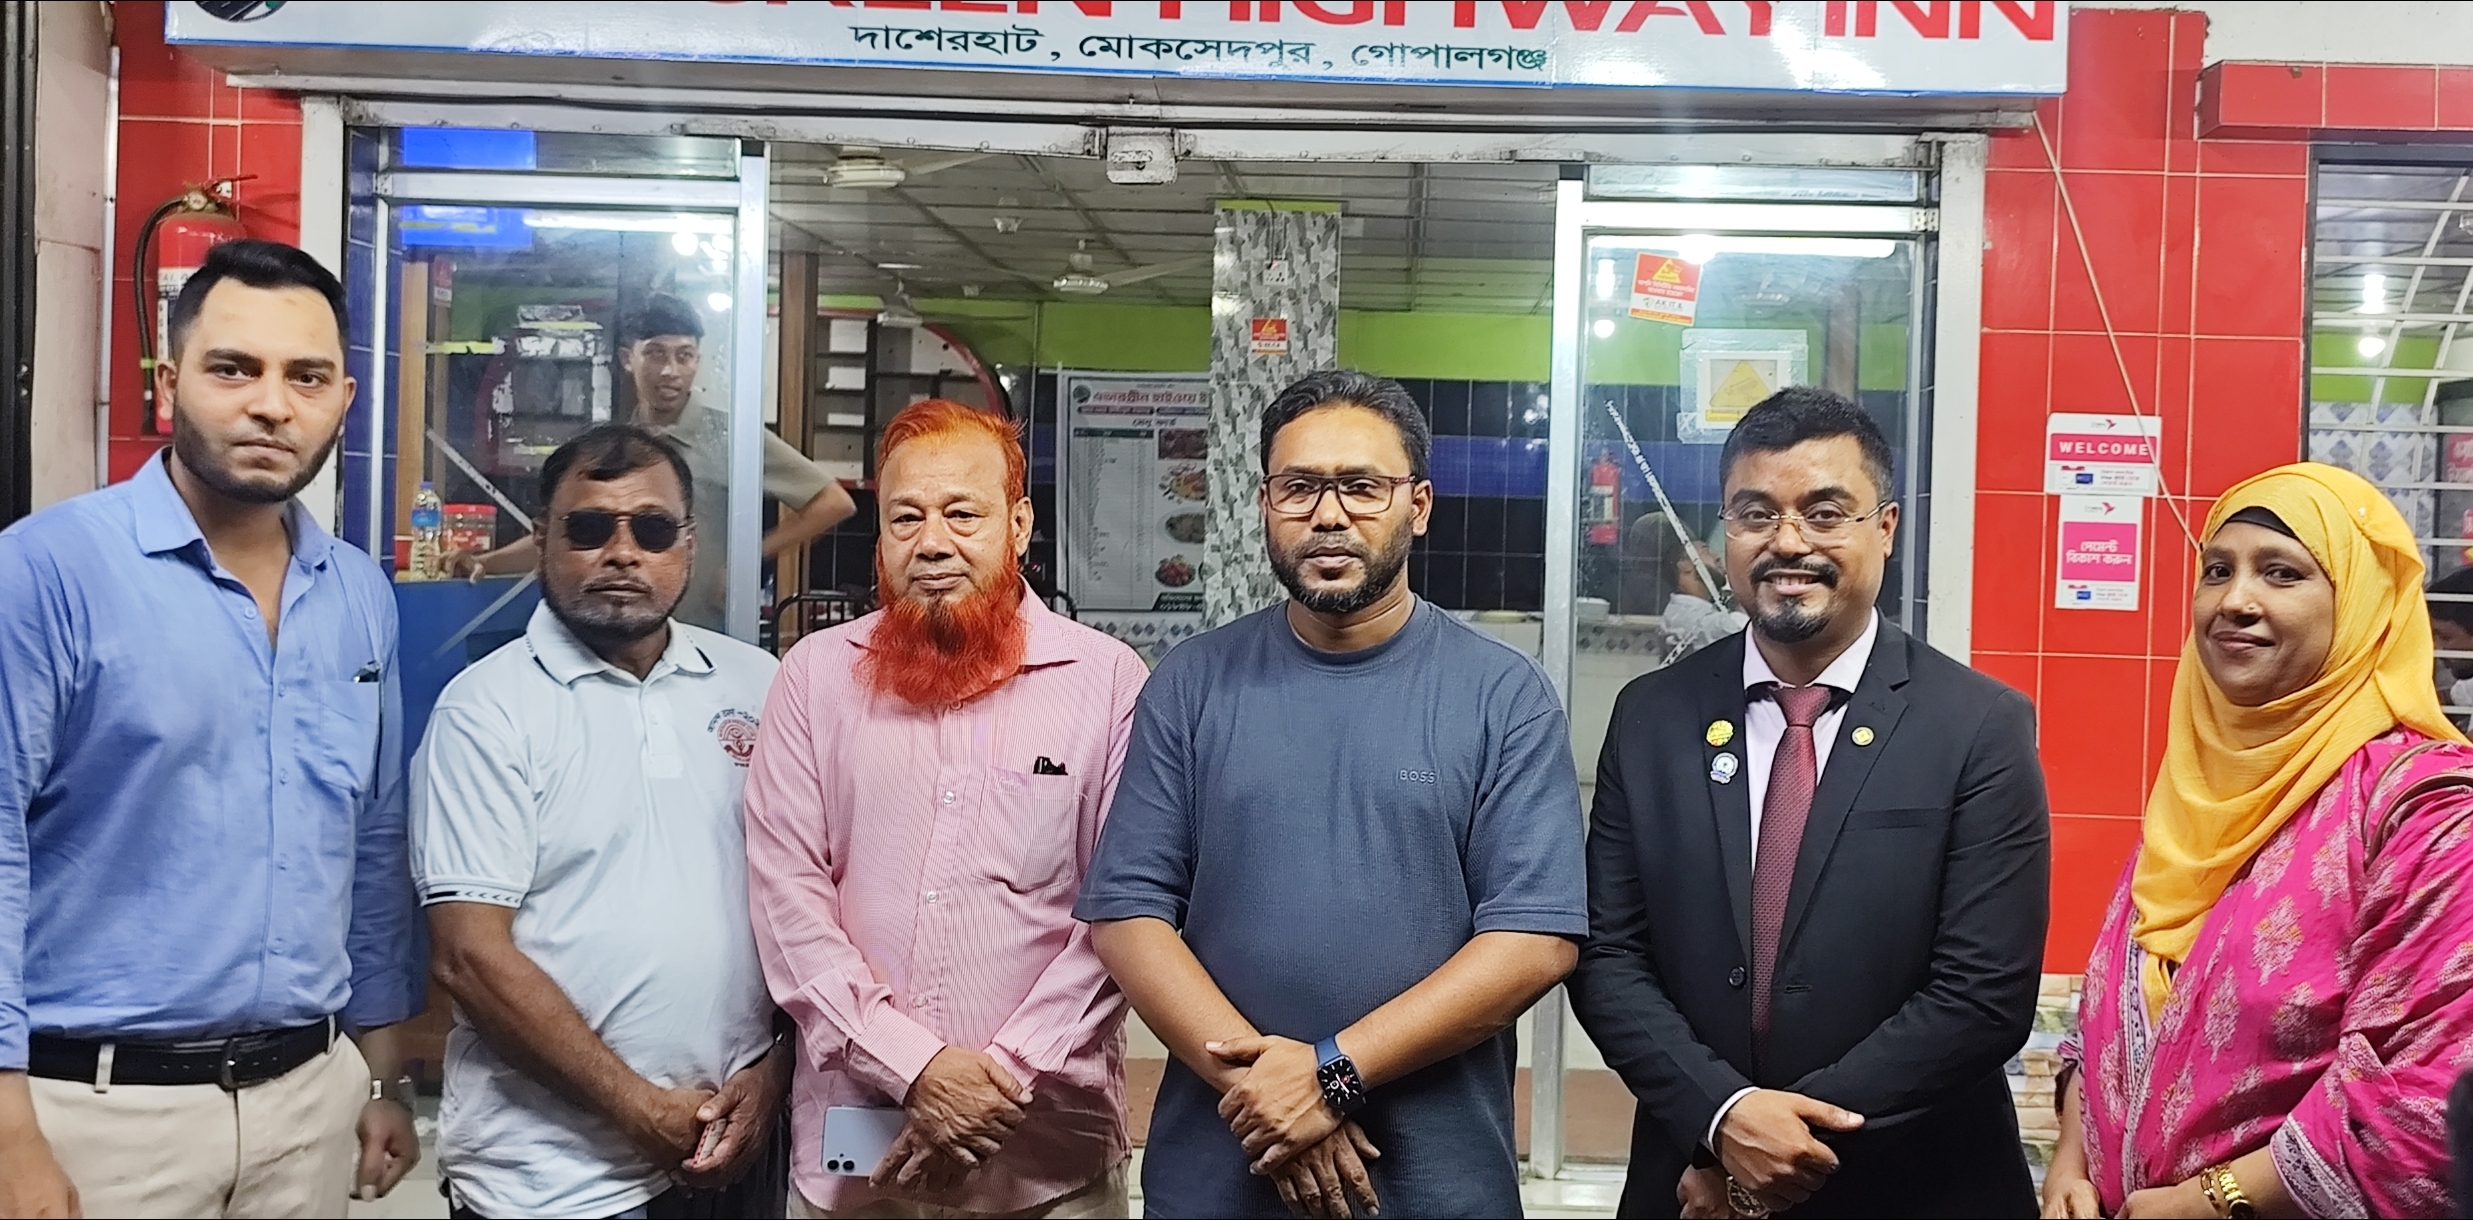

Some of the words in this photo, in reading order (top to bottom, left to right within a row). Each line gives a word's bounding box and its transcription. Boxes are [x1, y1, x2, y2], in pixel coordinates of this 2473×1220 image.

[1352, 42, 1547, 71] গোপালগঞ্জ
[2058, 440, 2150, 456] WELCOME
[2080, 539, 2119, 552] পেমেন্ট
[2066, 549, 2101, 564] বিকাশ
[2102, 553, 2134, 565] করুন
[1399, 769, 1436, 783] BOSS
